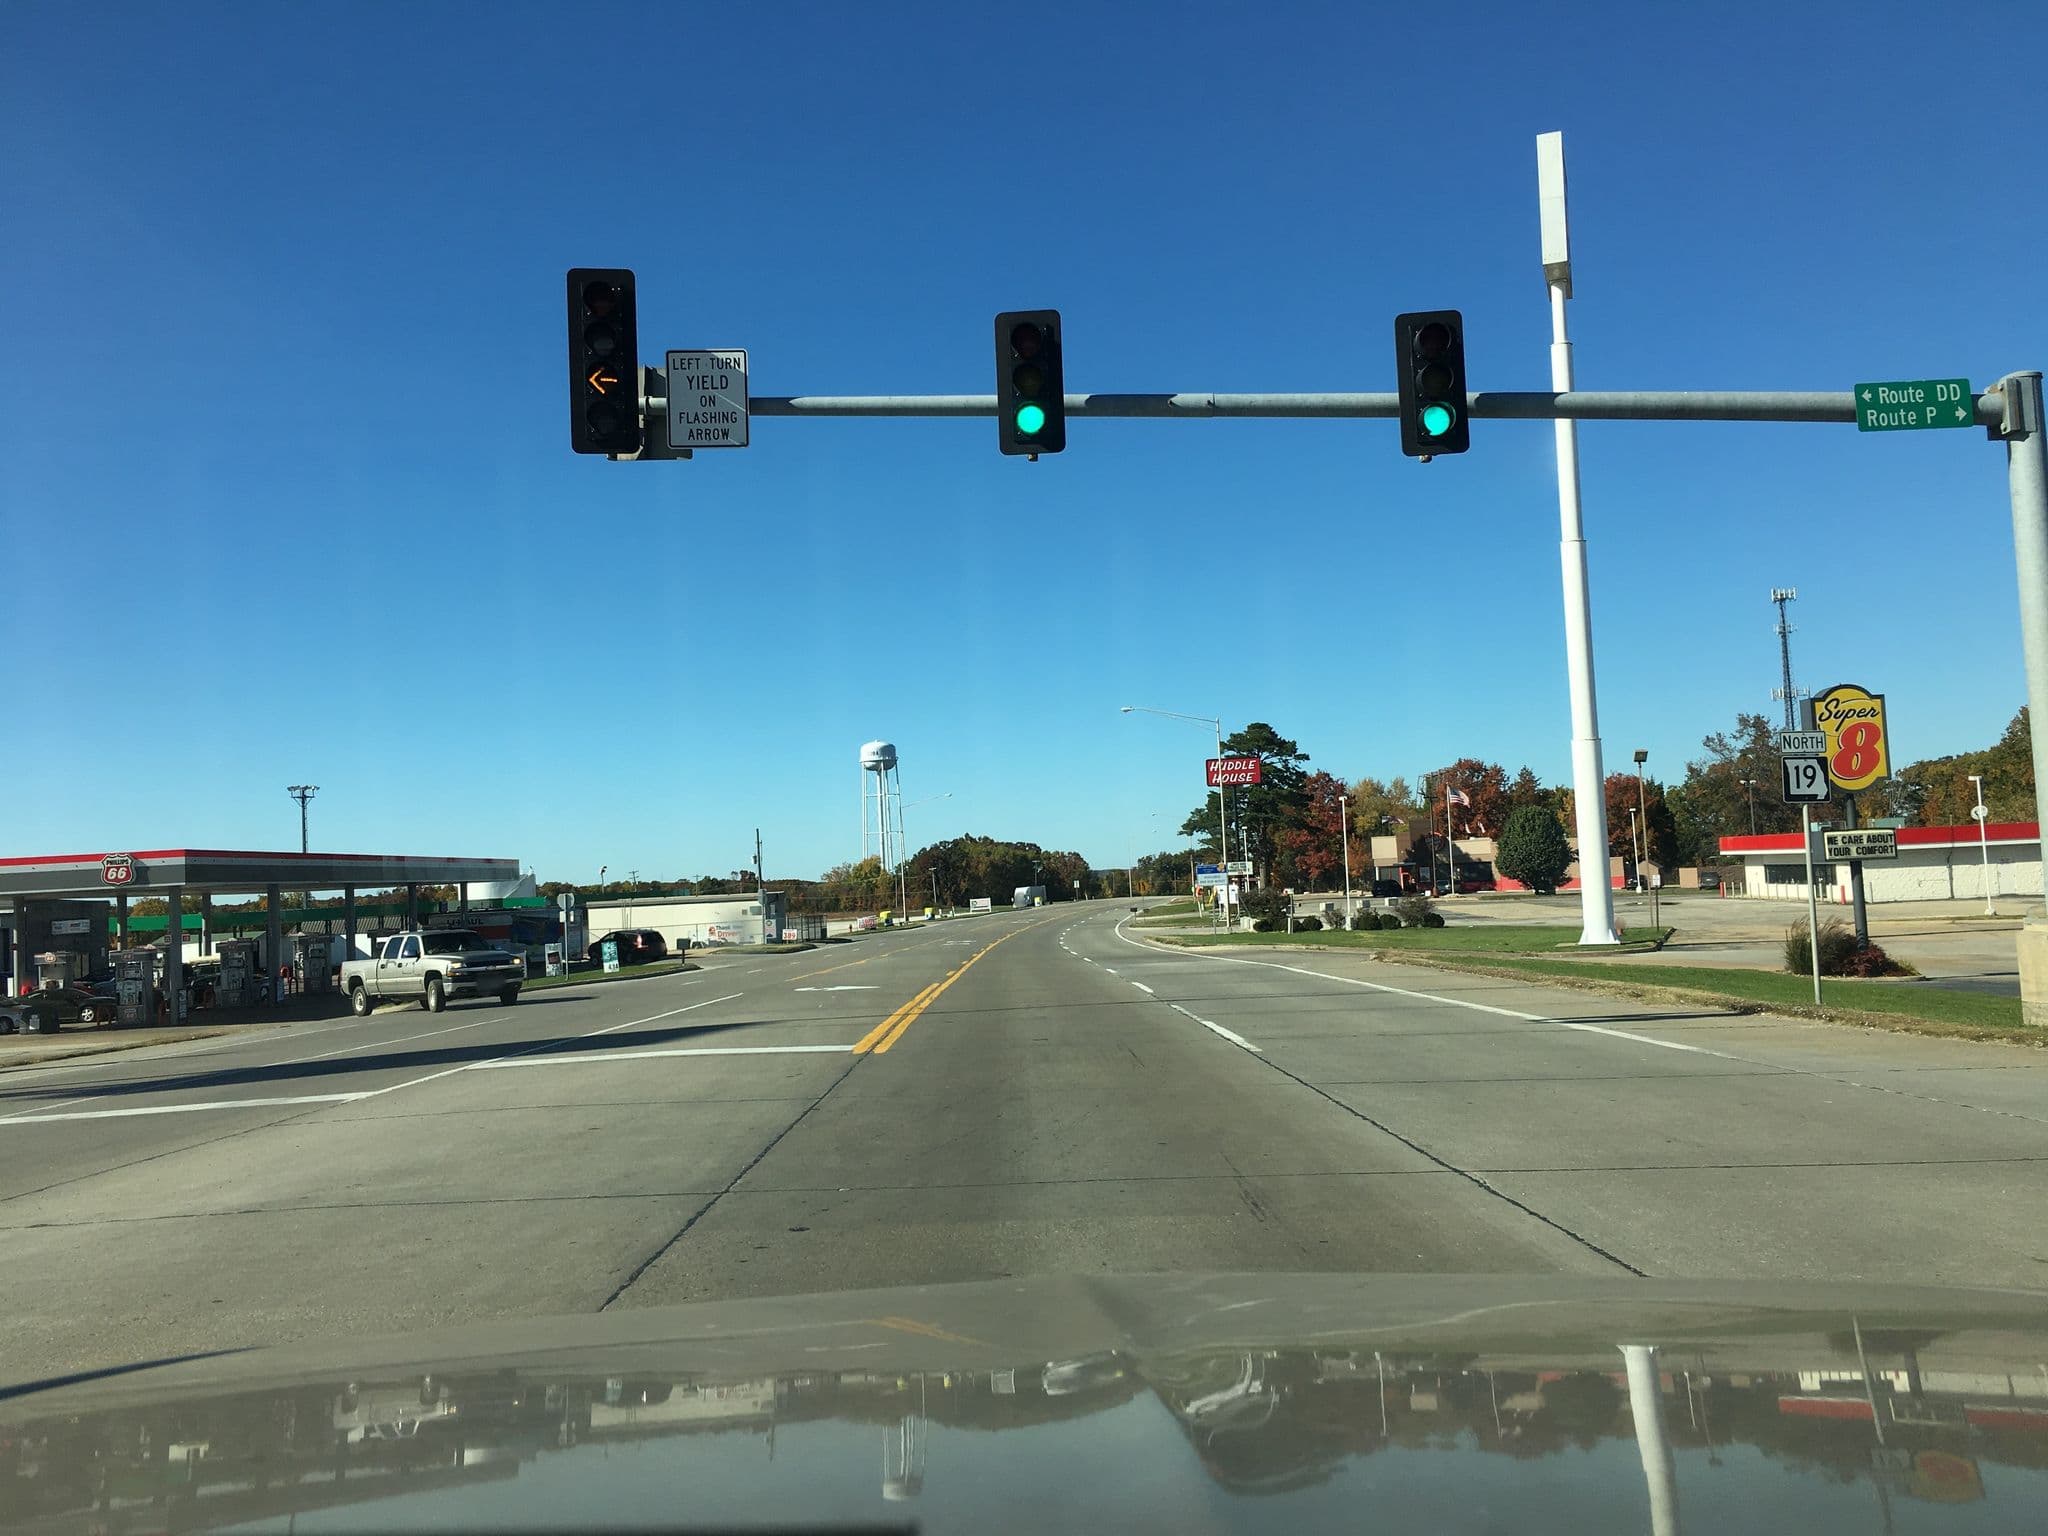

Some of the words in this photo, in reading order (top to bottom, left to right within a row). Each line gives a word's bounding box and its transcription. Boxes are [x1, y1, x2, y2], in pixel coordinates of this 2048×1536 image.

[672, 358, 700, 370] LEFT
[709, 357, 741, 370] TURN
[686, 374, 729, 390] YIELD
[1878, 386, 1925, 404] Route
[1936, 383, 1961, 402] DD
[700, 395, 716, 408] ON
[679, 411, 738, 424] FLASHING
[1866, 408, 1917, 427] Route
[1926, 406, 1937, 424] P
[687, 428, 730, 441] ARROW
[1818, 697, 1880, 732] Super
[1782, 735, 1824, 749] NORTH
[1830, 720, 1881, 781] 8
[1210, 760, 1256, 771] HUDDLE
[1212, 772, 1257, 784] HOUSE
[1793, 764, 1817, 789] 19
[1841, 834, 1864, 845] CARE
[1866, 833, 1893, 844] ABOUT
[1828, 847, 1851, 857] YOUR
[1855, 845, 1894, 856] COMFORT
[107, 867, 127, 880] 66
